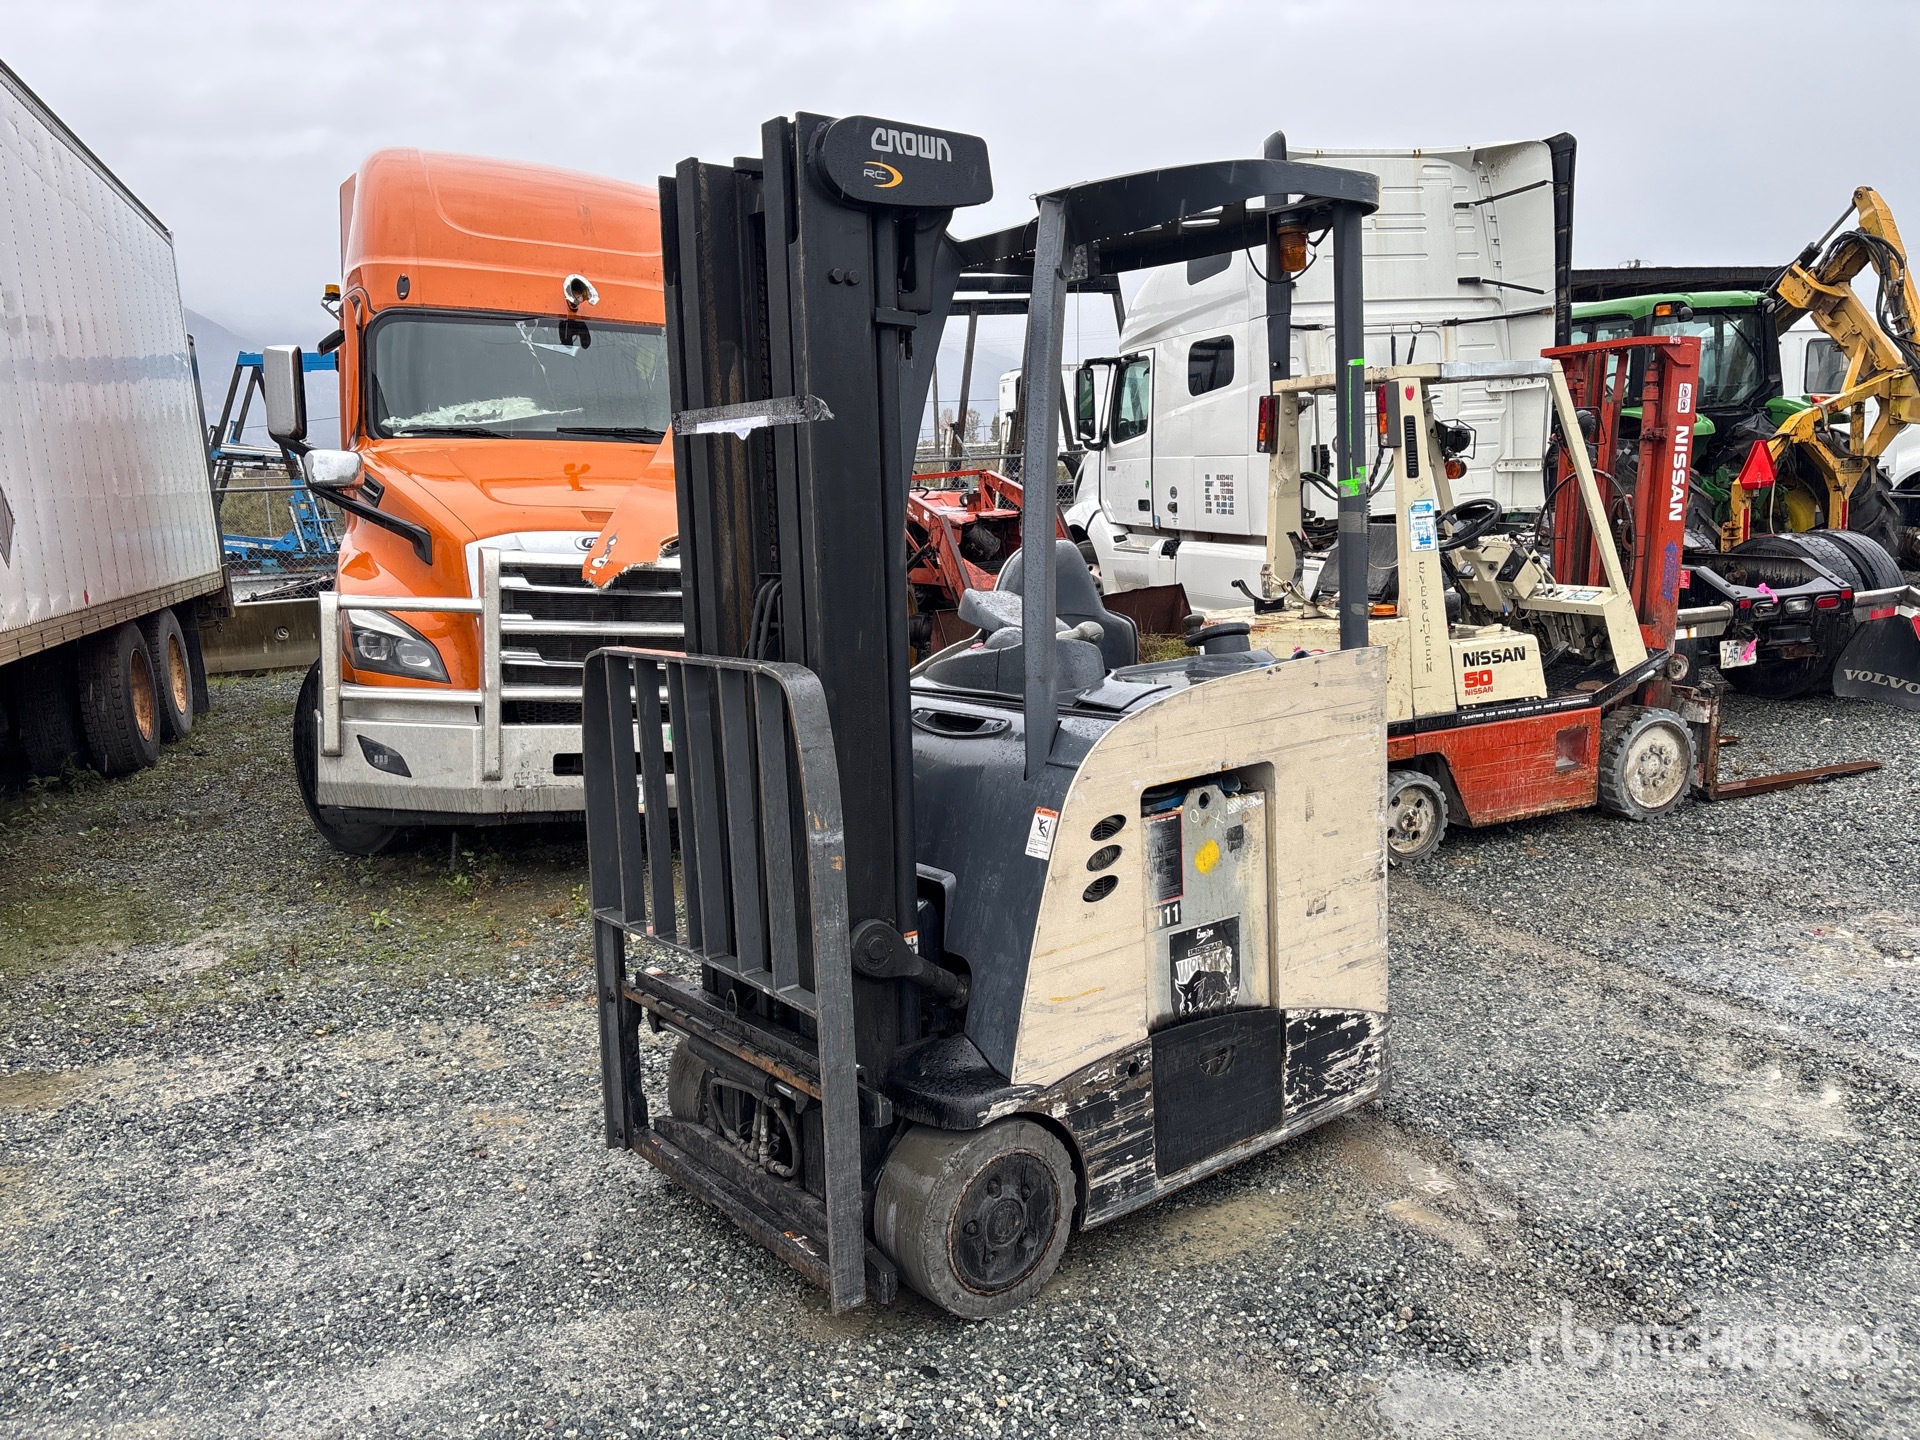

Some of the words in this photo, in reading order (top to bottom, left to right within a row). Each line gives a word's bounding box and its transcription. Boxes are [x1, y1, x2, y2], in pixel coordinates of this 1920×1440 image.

[870, 127, 952, 162] CROWN
[863, 168, 887, 181] RC
[1668, 425, 1690, 521] NISSAN
[1463, 646, 1526, 668] NISSAN
[1464, 669, 1493, 688] 50
[1843, 669, 1920, 695] VOLVO
[1464, 686, 1494, 696] NISSAN
